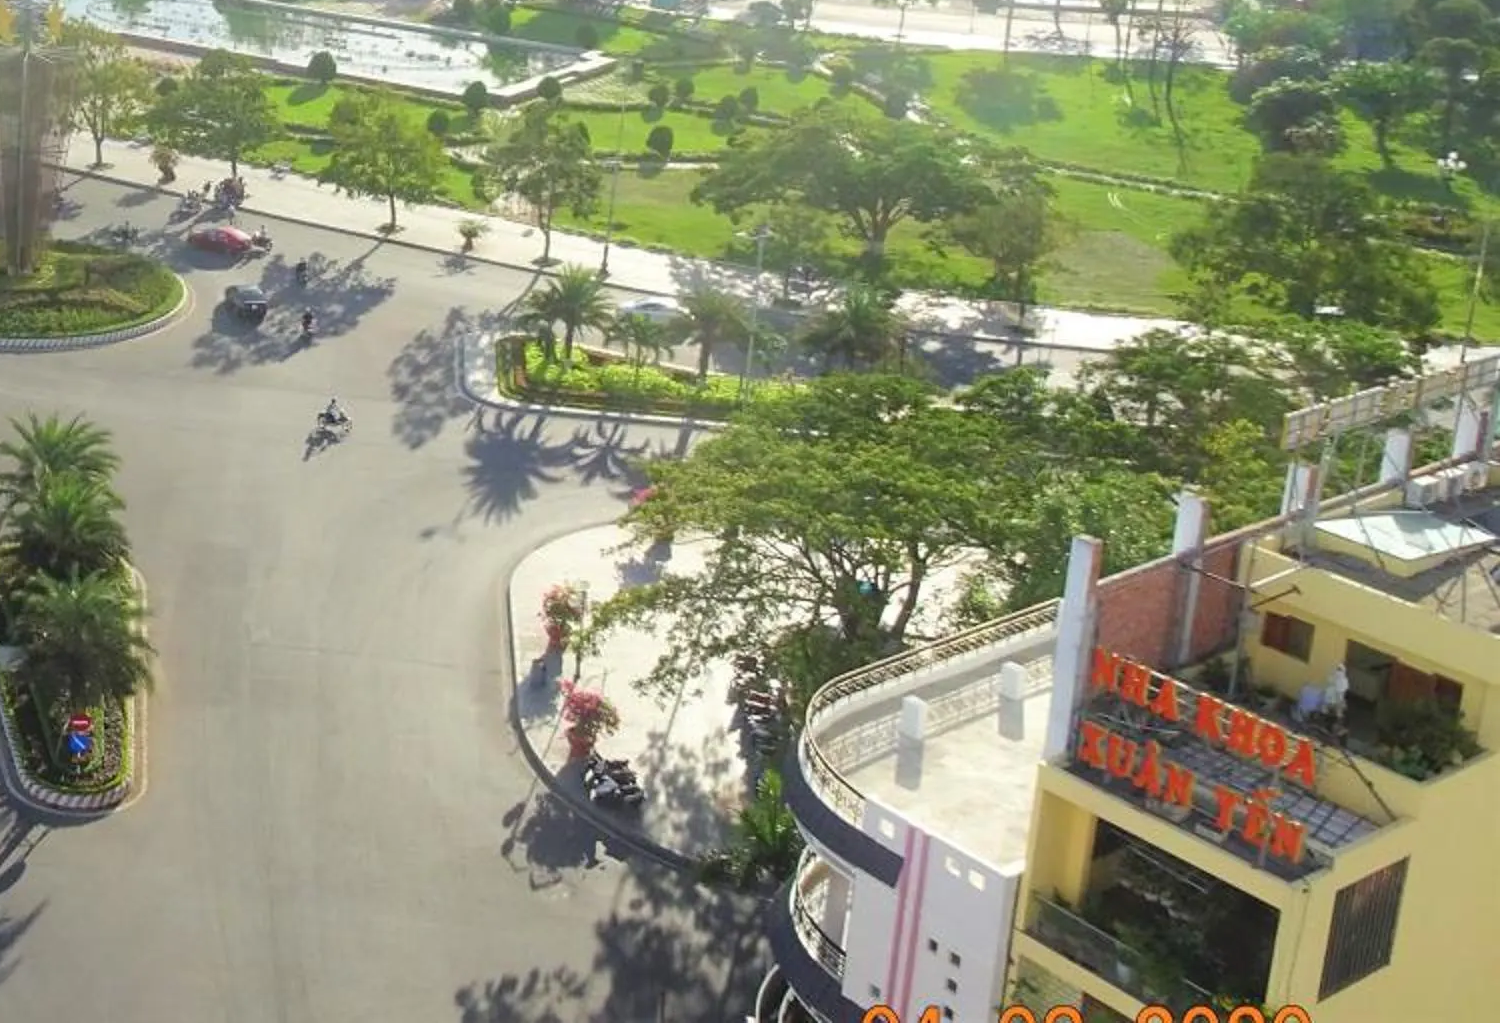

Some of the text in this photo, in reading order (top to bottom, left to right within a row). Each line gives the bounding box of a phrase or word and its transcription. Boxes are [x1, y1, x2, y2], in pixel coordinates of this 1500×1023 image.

[1077, 720, 1195, 807] XUÂN
[1091, 645, 1316, 787] NHA KHOA
